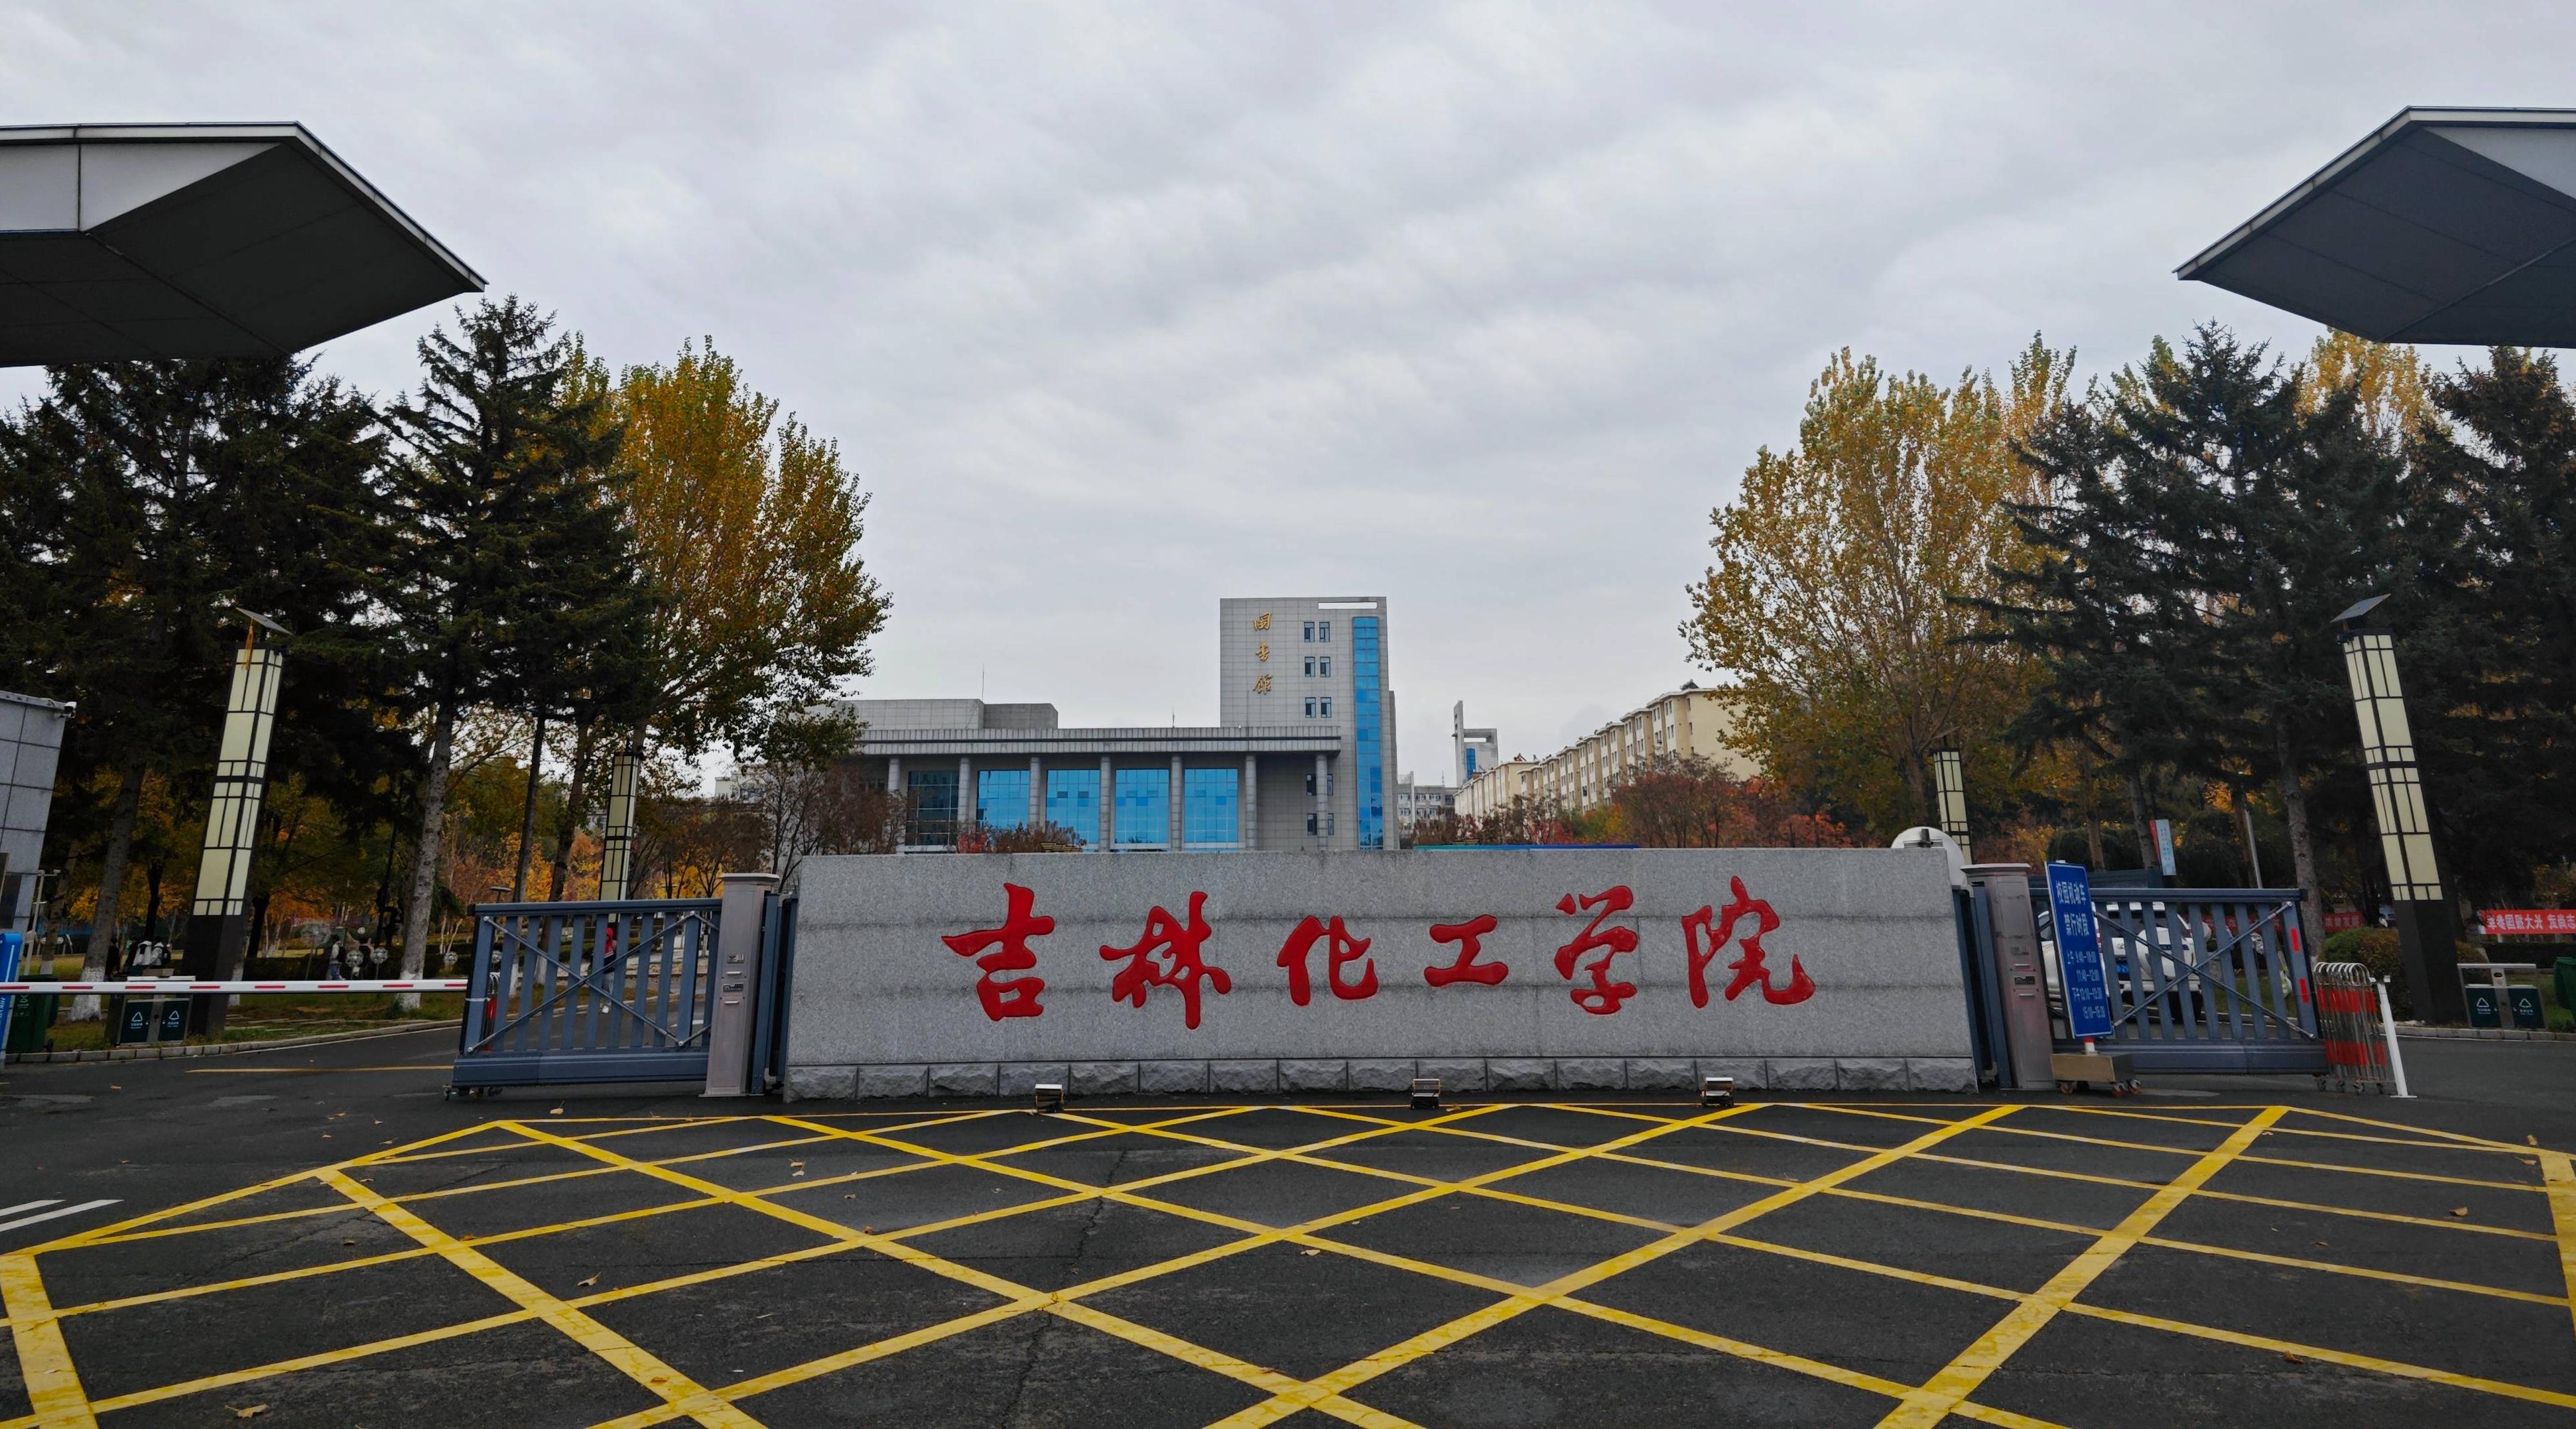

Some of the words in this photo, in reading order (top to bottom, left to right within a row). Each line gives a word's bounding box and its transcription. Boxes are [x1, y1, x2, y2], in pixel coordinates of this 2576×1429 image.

[2055, 881, 2087, 906] 校园机动车
[2063, 912, 2090, 936] 禁行时段
[941, 877, 1815, 1030] 吉林化工学院
